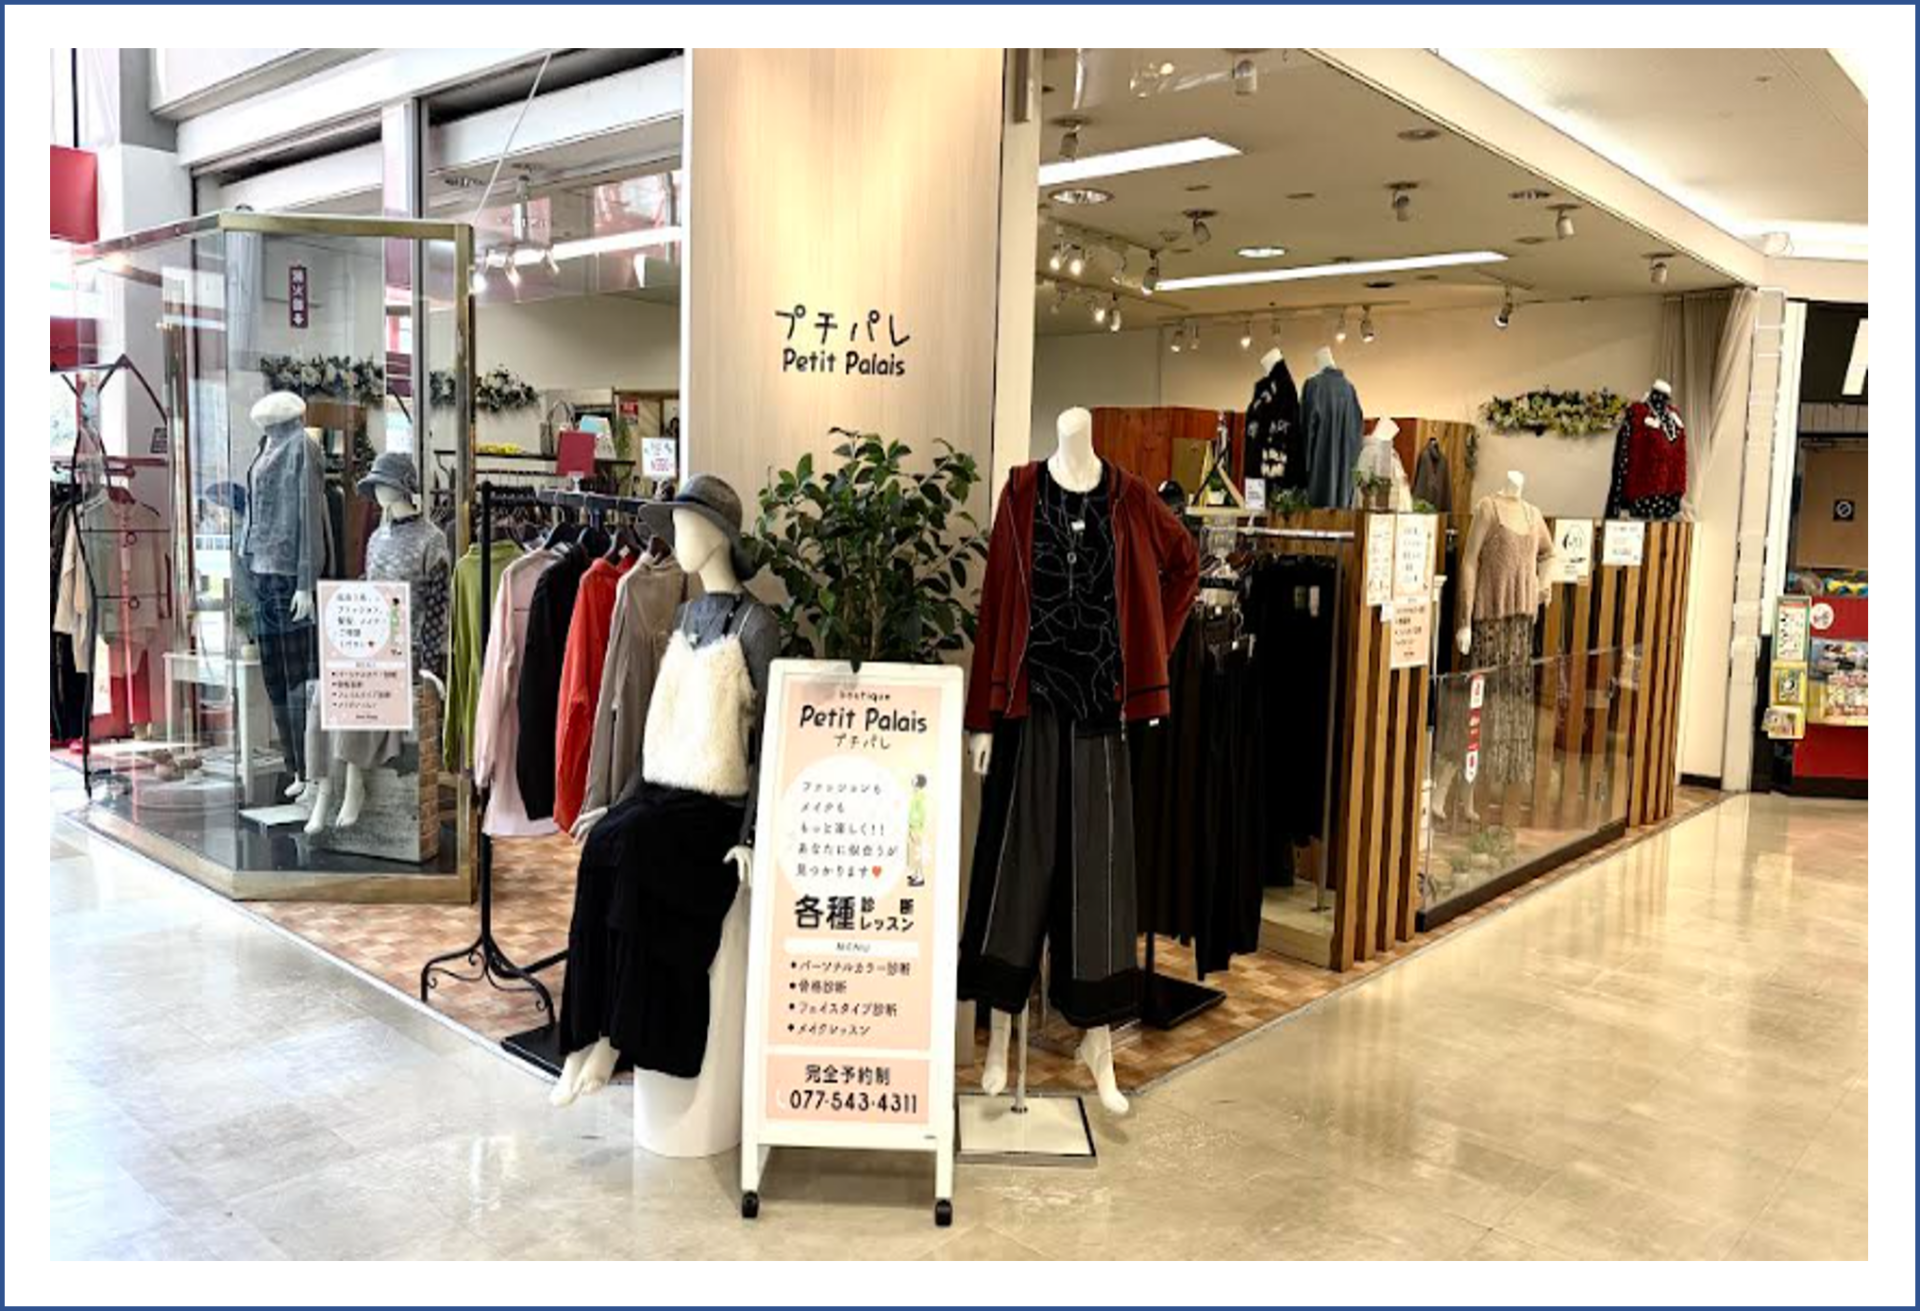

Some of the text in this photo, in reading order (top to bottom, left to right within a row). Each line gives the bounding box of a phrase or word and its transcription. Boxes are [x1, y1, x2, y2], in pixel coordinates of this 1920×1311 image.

[775, 304, 910, 347] プチパレ
[783, 347, 906, 376] Petit Palais
[839, 690, 891, 702] boutique
[799, 704, 928, 734] Petit Palais
[834, 733, 891, 750] プチパレ
[803, 781, 881, 796] ファッションも
[801, 801, 845, 814] メイクも
[798, 842, 898, 857] あなたに似合うが
[795, 863, 869, 879] 見つかります
[794, 893, 856, 931] 各種
[861, 915, 915, 932] レッスン
[836, 942, 871, 953] MENU
[798, 1022, 872, 1037] メイクレッスン
[805, 1064, 890, 1086] 完全予約制
